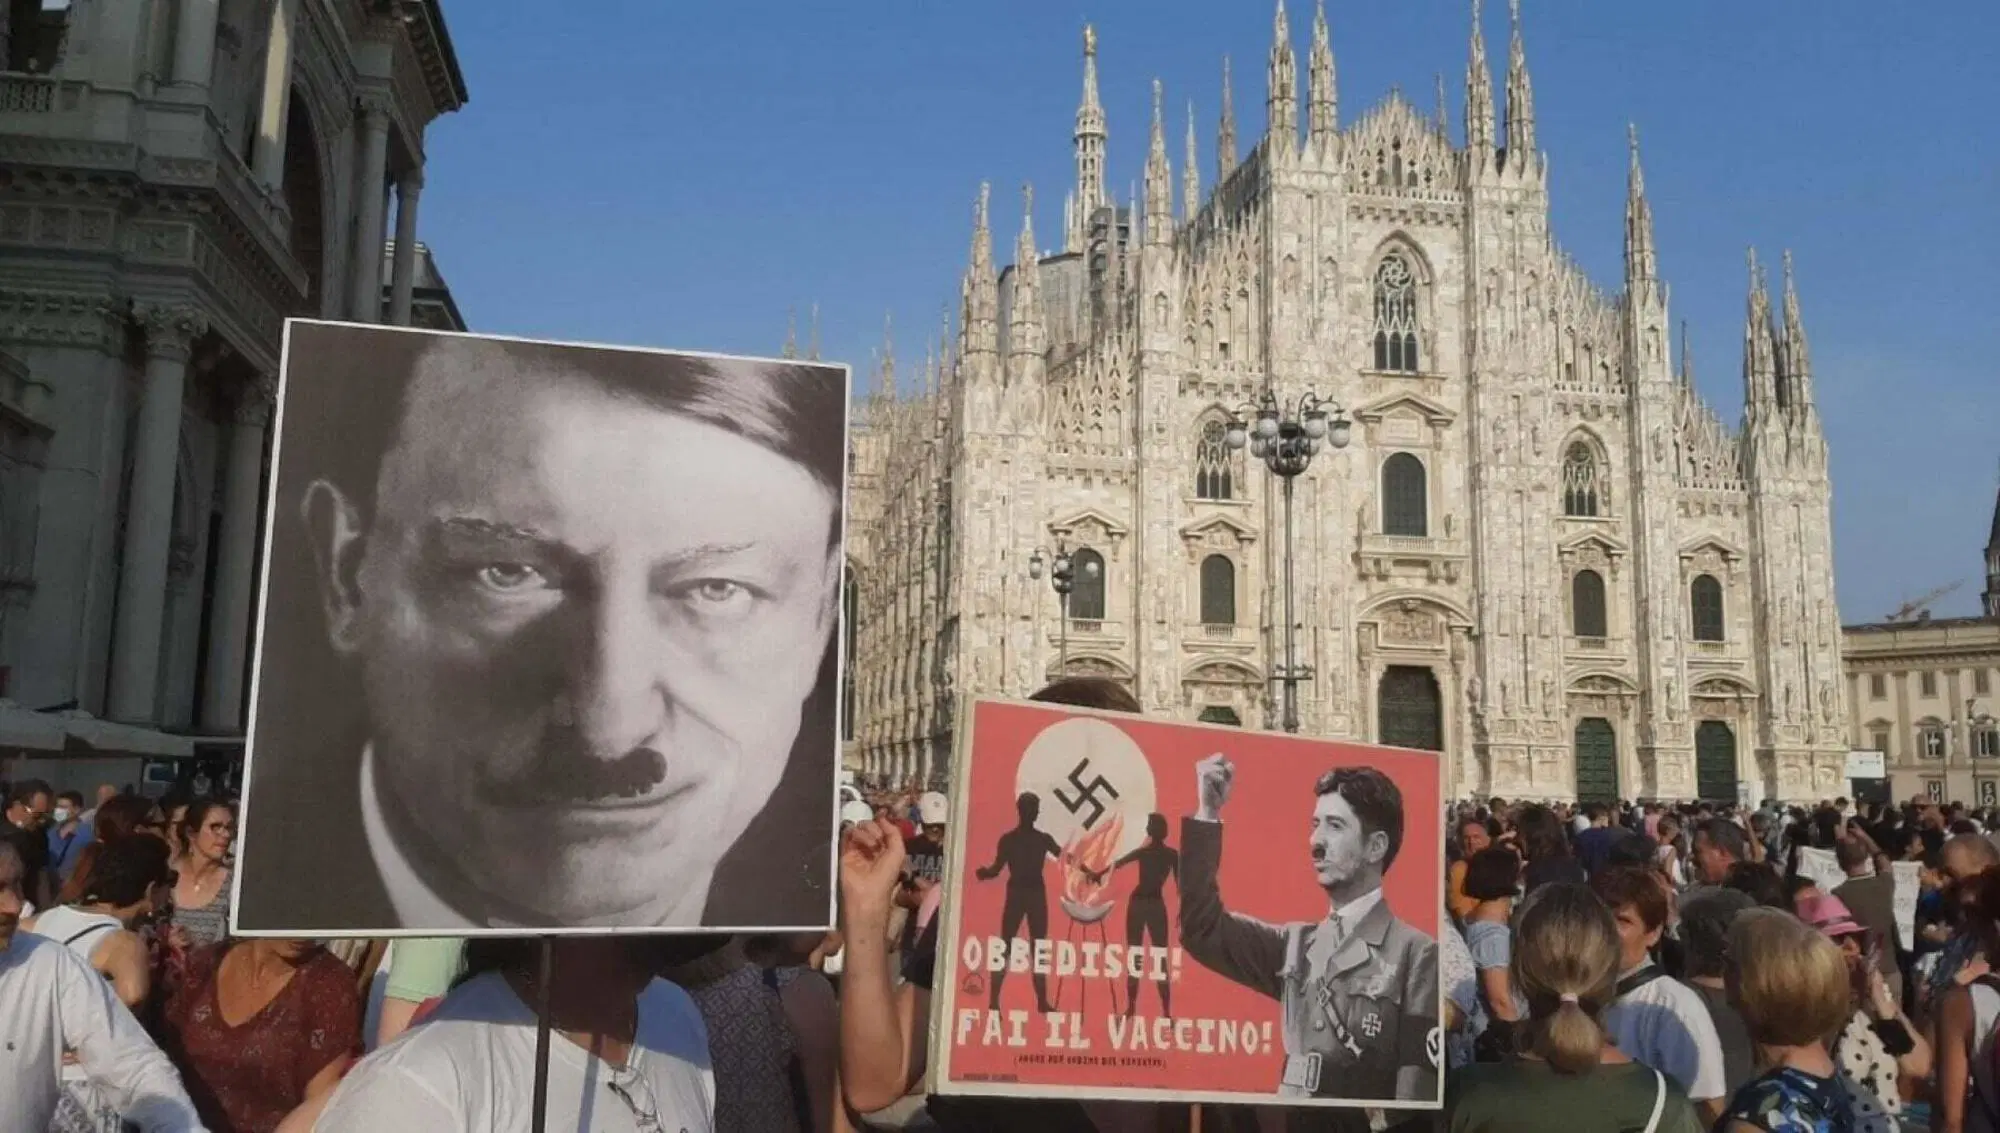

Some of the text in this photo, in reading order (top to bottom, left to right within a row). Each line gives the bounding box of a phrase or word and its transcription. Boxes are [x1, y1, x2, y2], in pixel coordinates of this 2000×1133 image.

[962, 935, 1183, 981] OBBEDISCI!
[957, 1008, 1273, 1055] FAI IL VACCINO!
